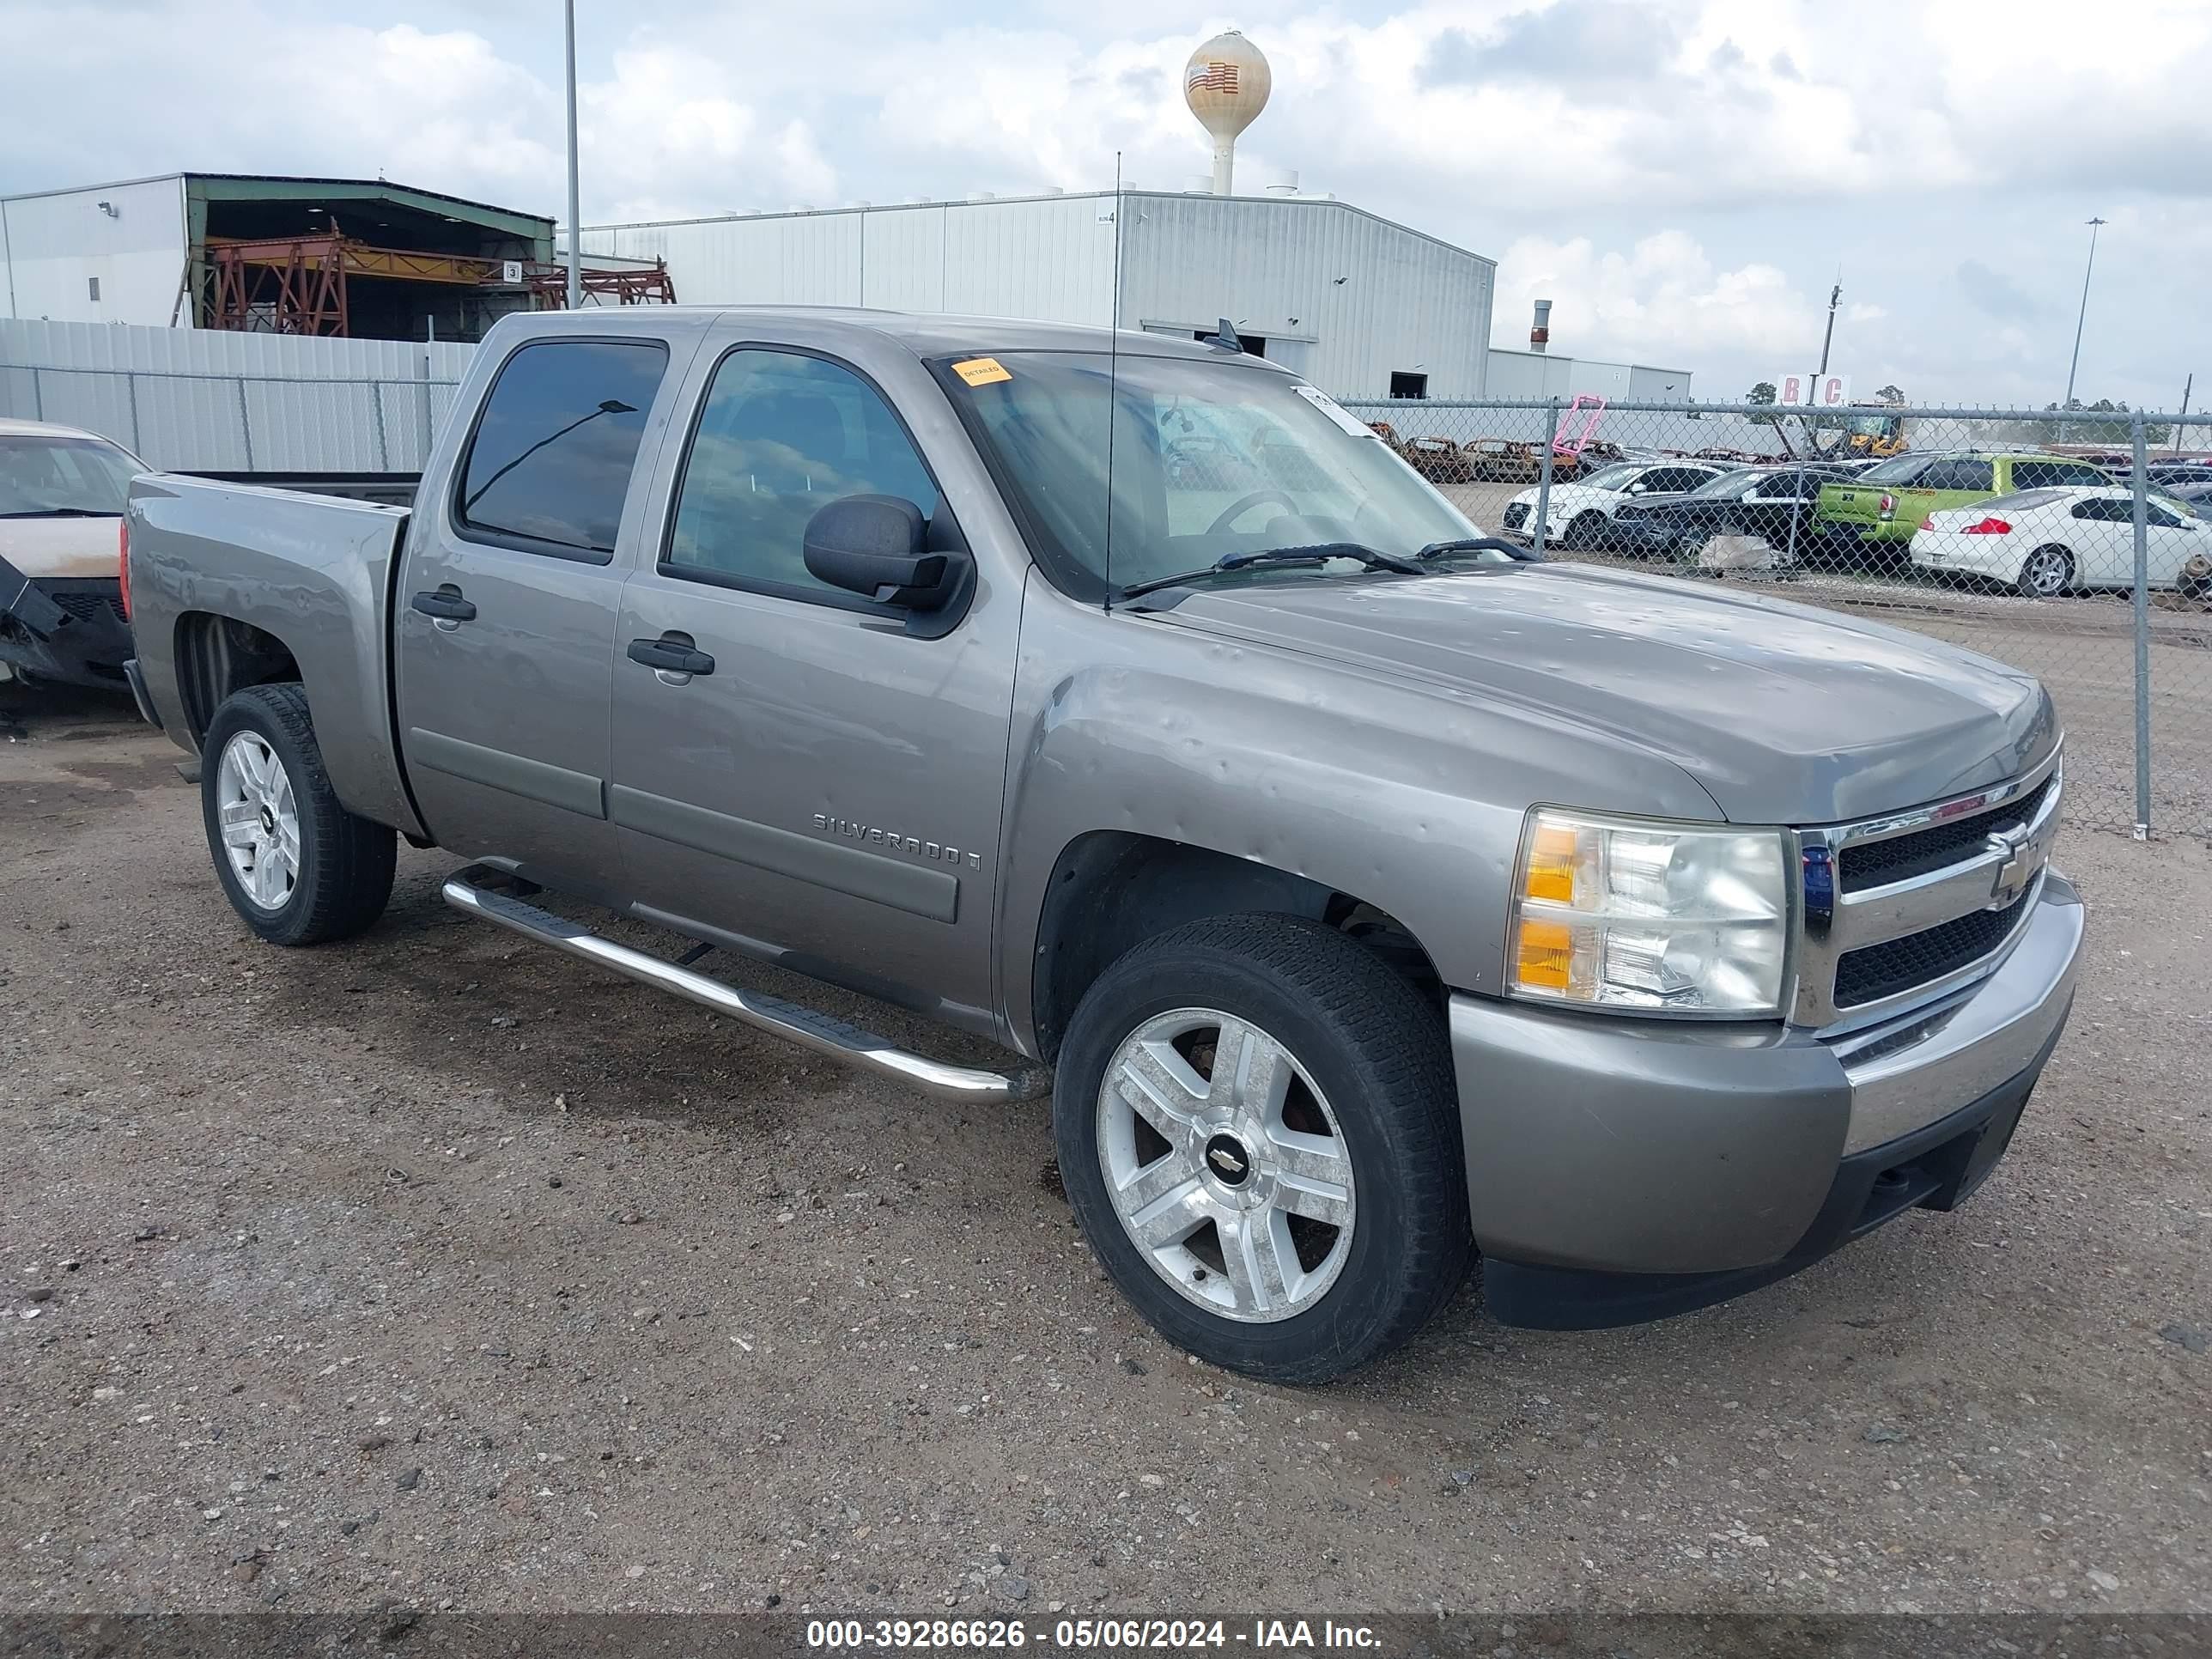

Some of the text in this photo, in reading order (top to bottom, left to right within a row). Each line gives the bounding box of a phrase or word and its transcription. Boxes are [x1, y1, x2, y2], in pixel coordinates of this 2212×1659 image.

[1109, 212, 1115, 223] 4
[509, 268, 516, 277] 3
[963, 367, 1000, 378] DETAILED
[1784, 377, 1800, 403] B
[1825, 378, 1842, 404] C
[812, 813, 962, 866] SILVERADO
